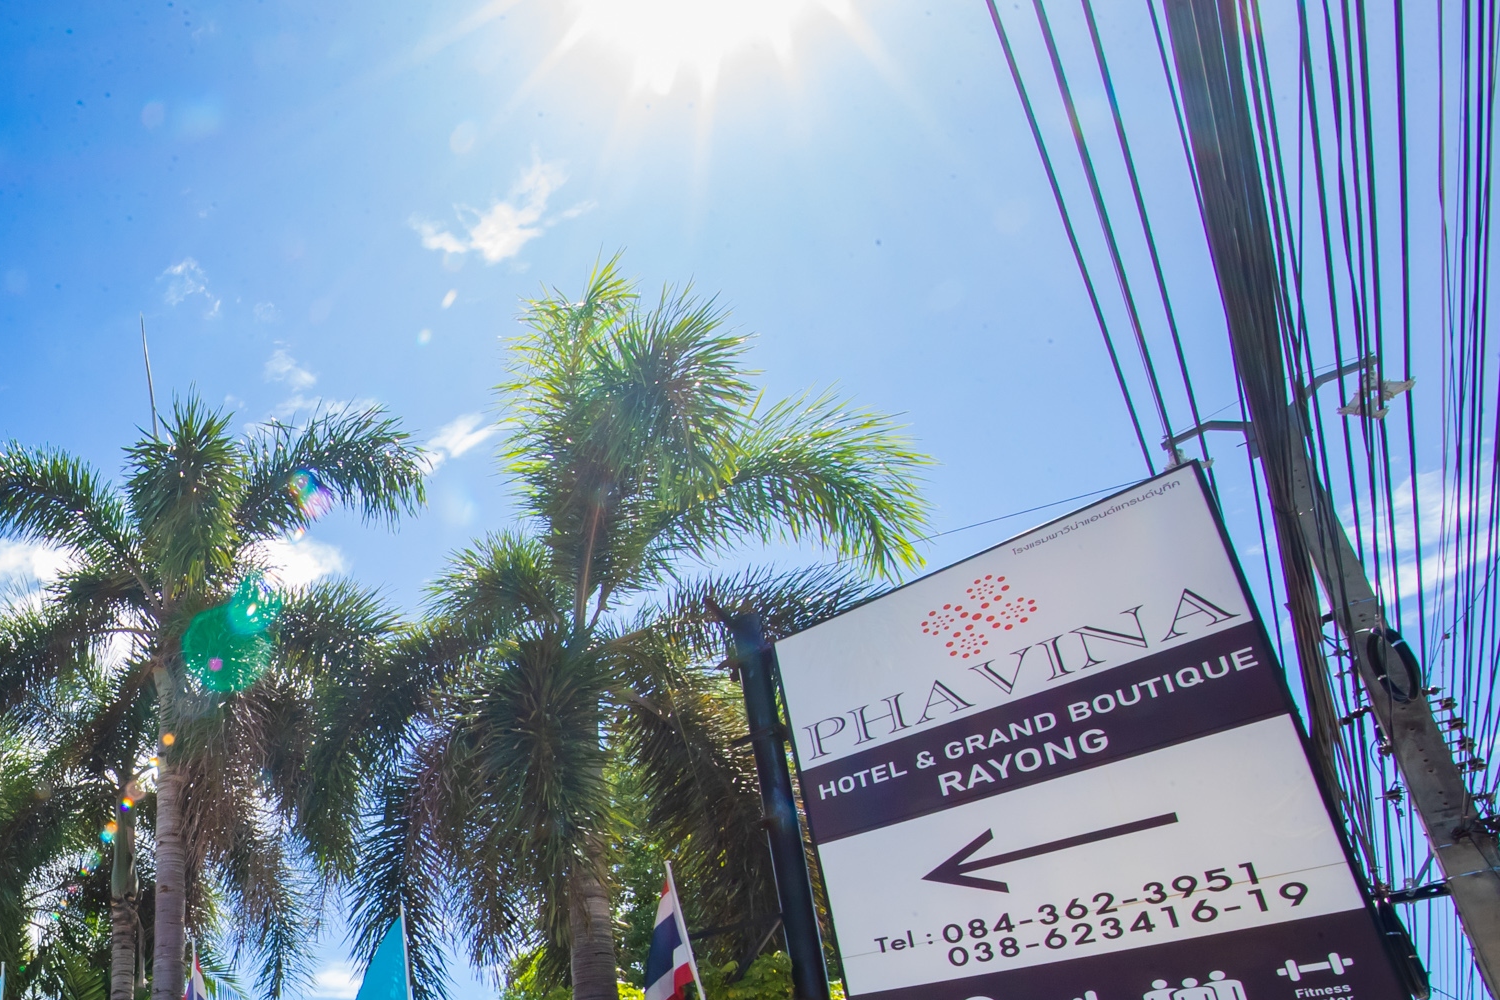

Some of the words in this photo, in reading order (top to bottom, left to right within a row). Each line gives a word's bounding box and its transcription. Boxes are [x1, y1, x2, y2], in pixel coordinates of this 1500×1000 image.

[802, 587, 1243, 762] PHAVINA
[818, 763, 908, 800] HOTEL
[915, 750, 937, 770] &
[944, 711, 1058, 761] GRAND
[1067, 646, 1260, 723] BOUTIQUE
[937, 728, 1111, 797] RAYONG
[874, 930, 915, 955] Tel
[942, 861, 1261, 944] 084-362-3951
[947, 881, 1310, 967] 038-623416-19
[1295, 983, 1352, 999] Fitness
